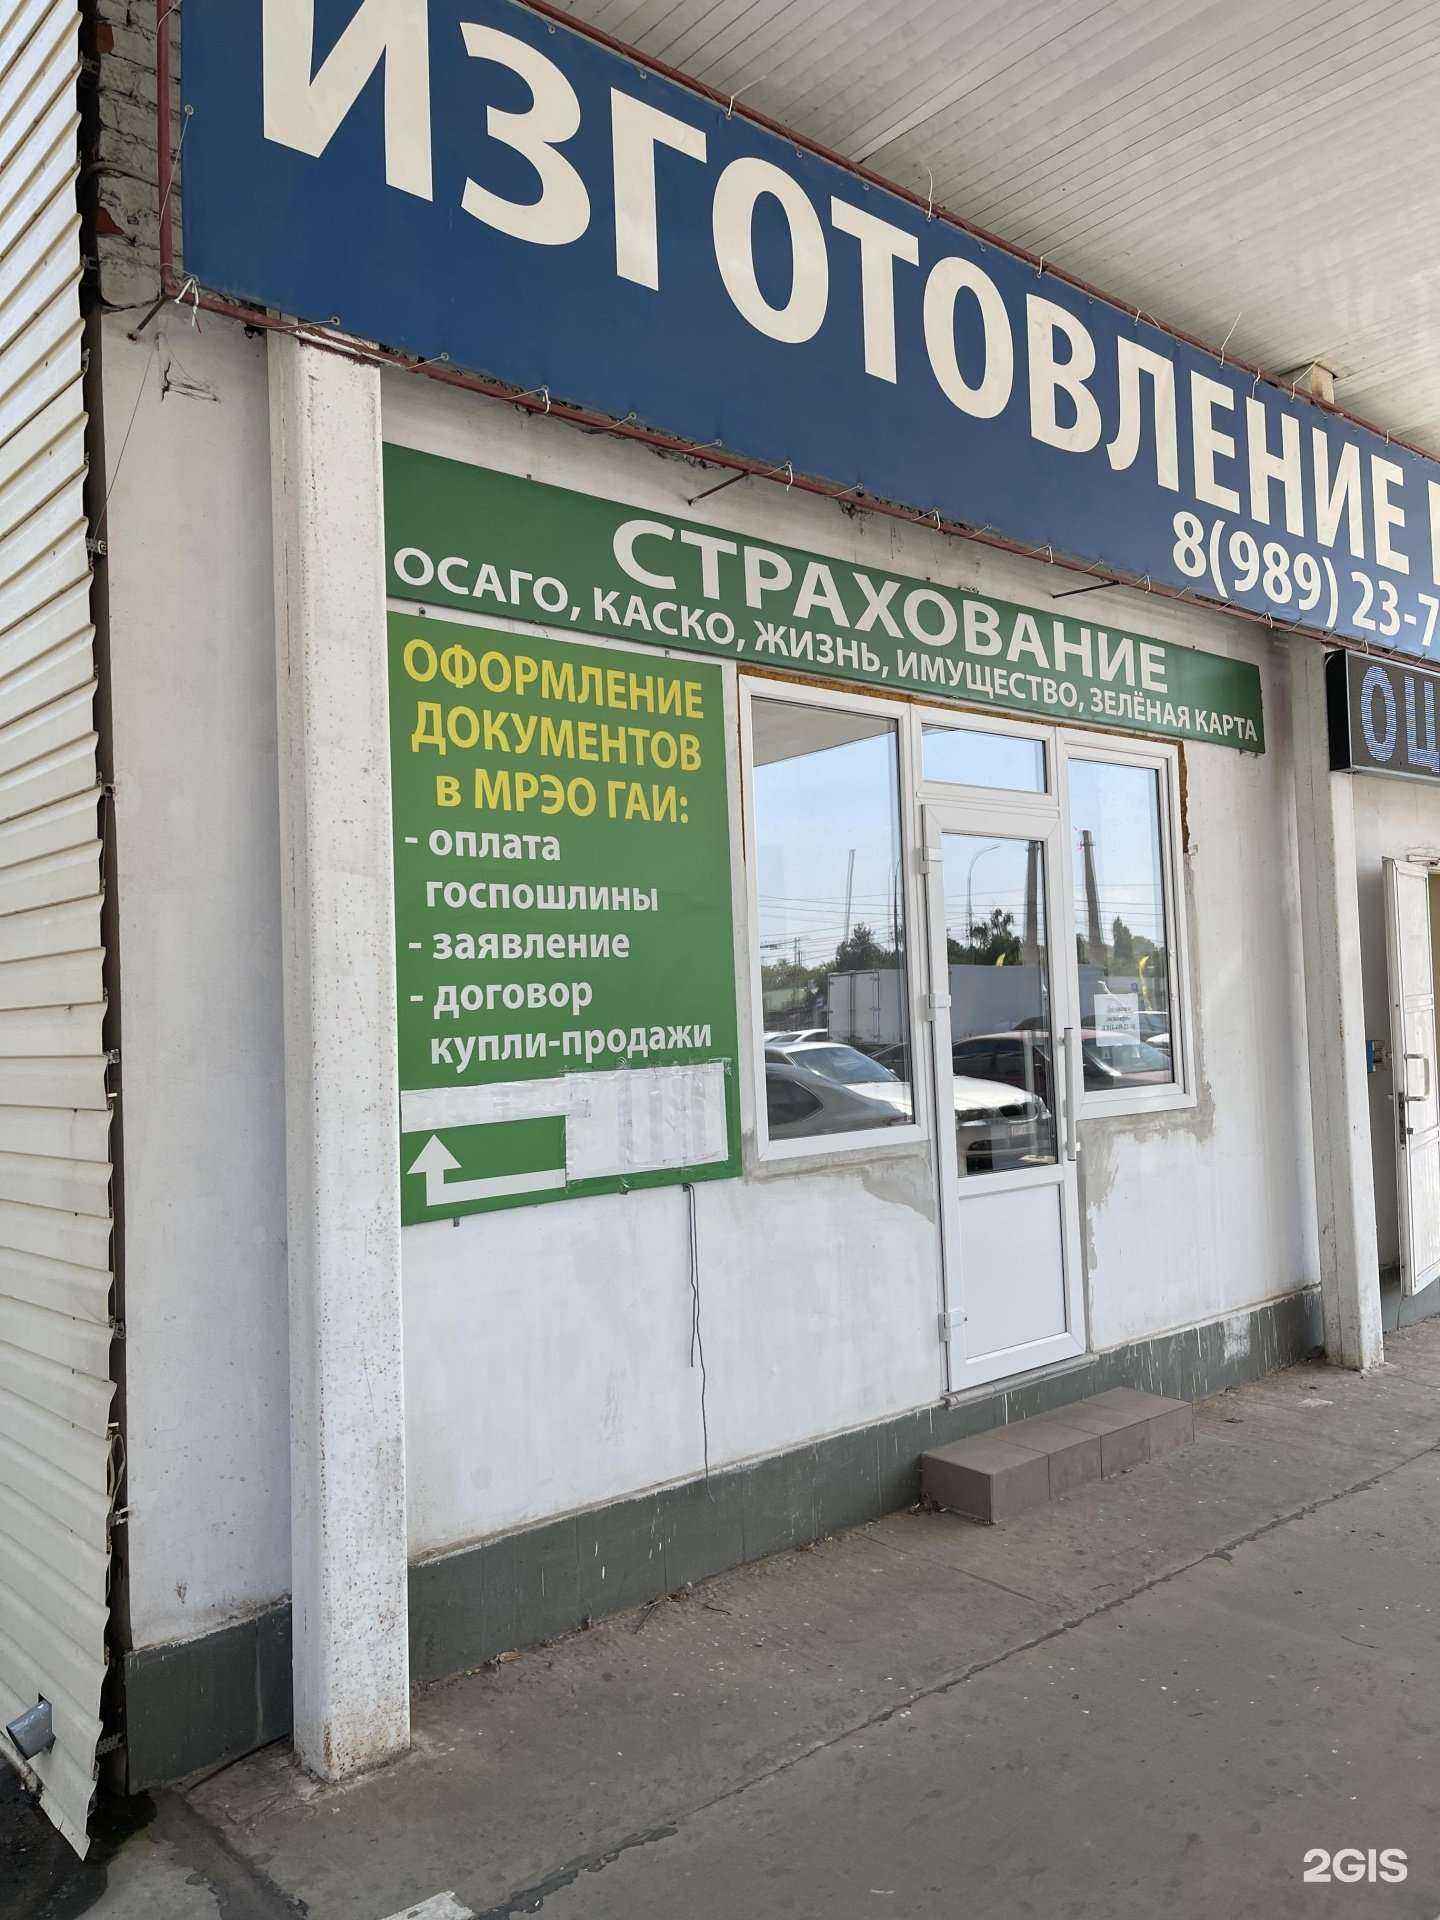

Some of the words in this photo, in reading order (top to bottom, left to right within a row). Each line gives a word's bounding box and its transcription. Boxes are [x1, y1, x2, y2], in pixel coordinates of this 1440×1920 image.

[263, 0, 1410, 576] ИЗГОТОВЛЕНИЕ
[612, 519, 1169, 694] СТРАХОВАНИЕ
[1172, 511, 1338, 628] 8(989)
[1351, 570, 1440, 647] 23-7
[393, 547, 581, 622] ОСАГО,
[593, 587, 746, 653] КАСКО,
[754, 619, 889, 679] ЖИЗНЬ,
[896, 649, 1085, 714] ИМУЩЕСТВО,
[1090, 686, 1190, 728] ЗЕЛЁНАЯ
[1195, 710, 1258, 742] КАРТА
[403, 638, 705, 720] ОФОРМЛЕНИЕ
[411, 701, 702, 772] ДОКУМЕНТОВ
[436, 775, 462, 808] в
[474, 768, 597, 818] МРЭО
[608, 780, 690, 824] ГАИ:
[428, 828, 561, 861] оплата
[426, 881, 659, 911] госпошлины
[432, 932, 630, 960] заявление
[433, 981, 593, 1019] договор
[431, 1023, 712, 1074] купли-продажи
